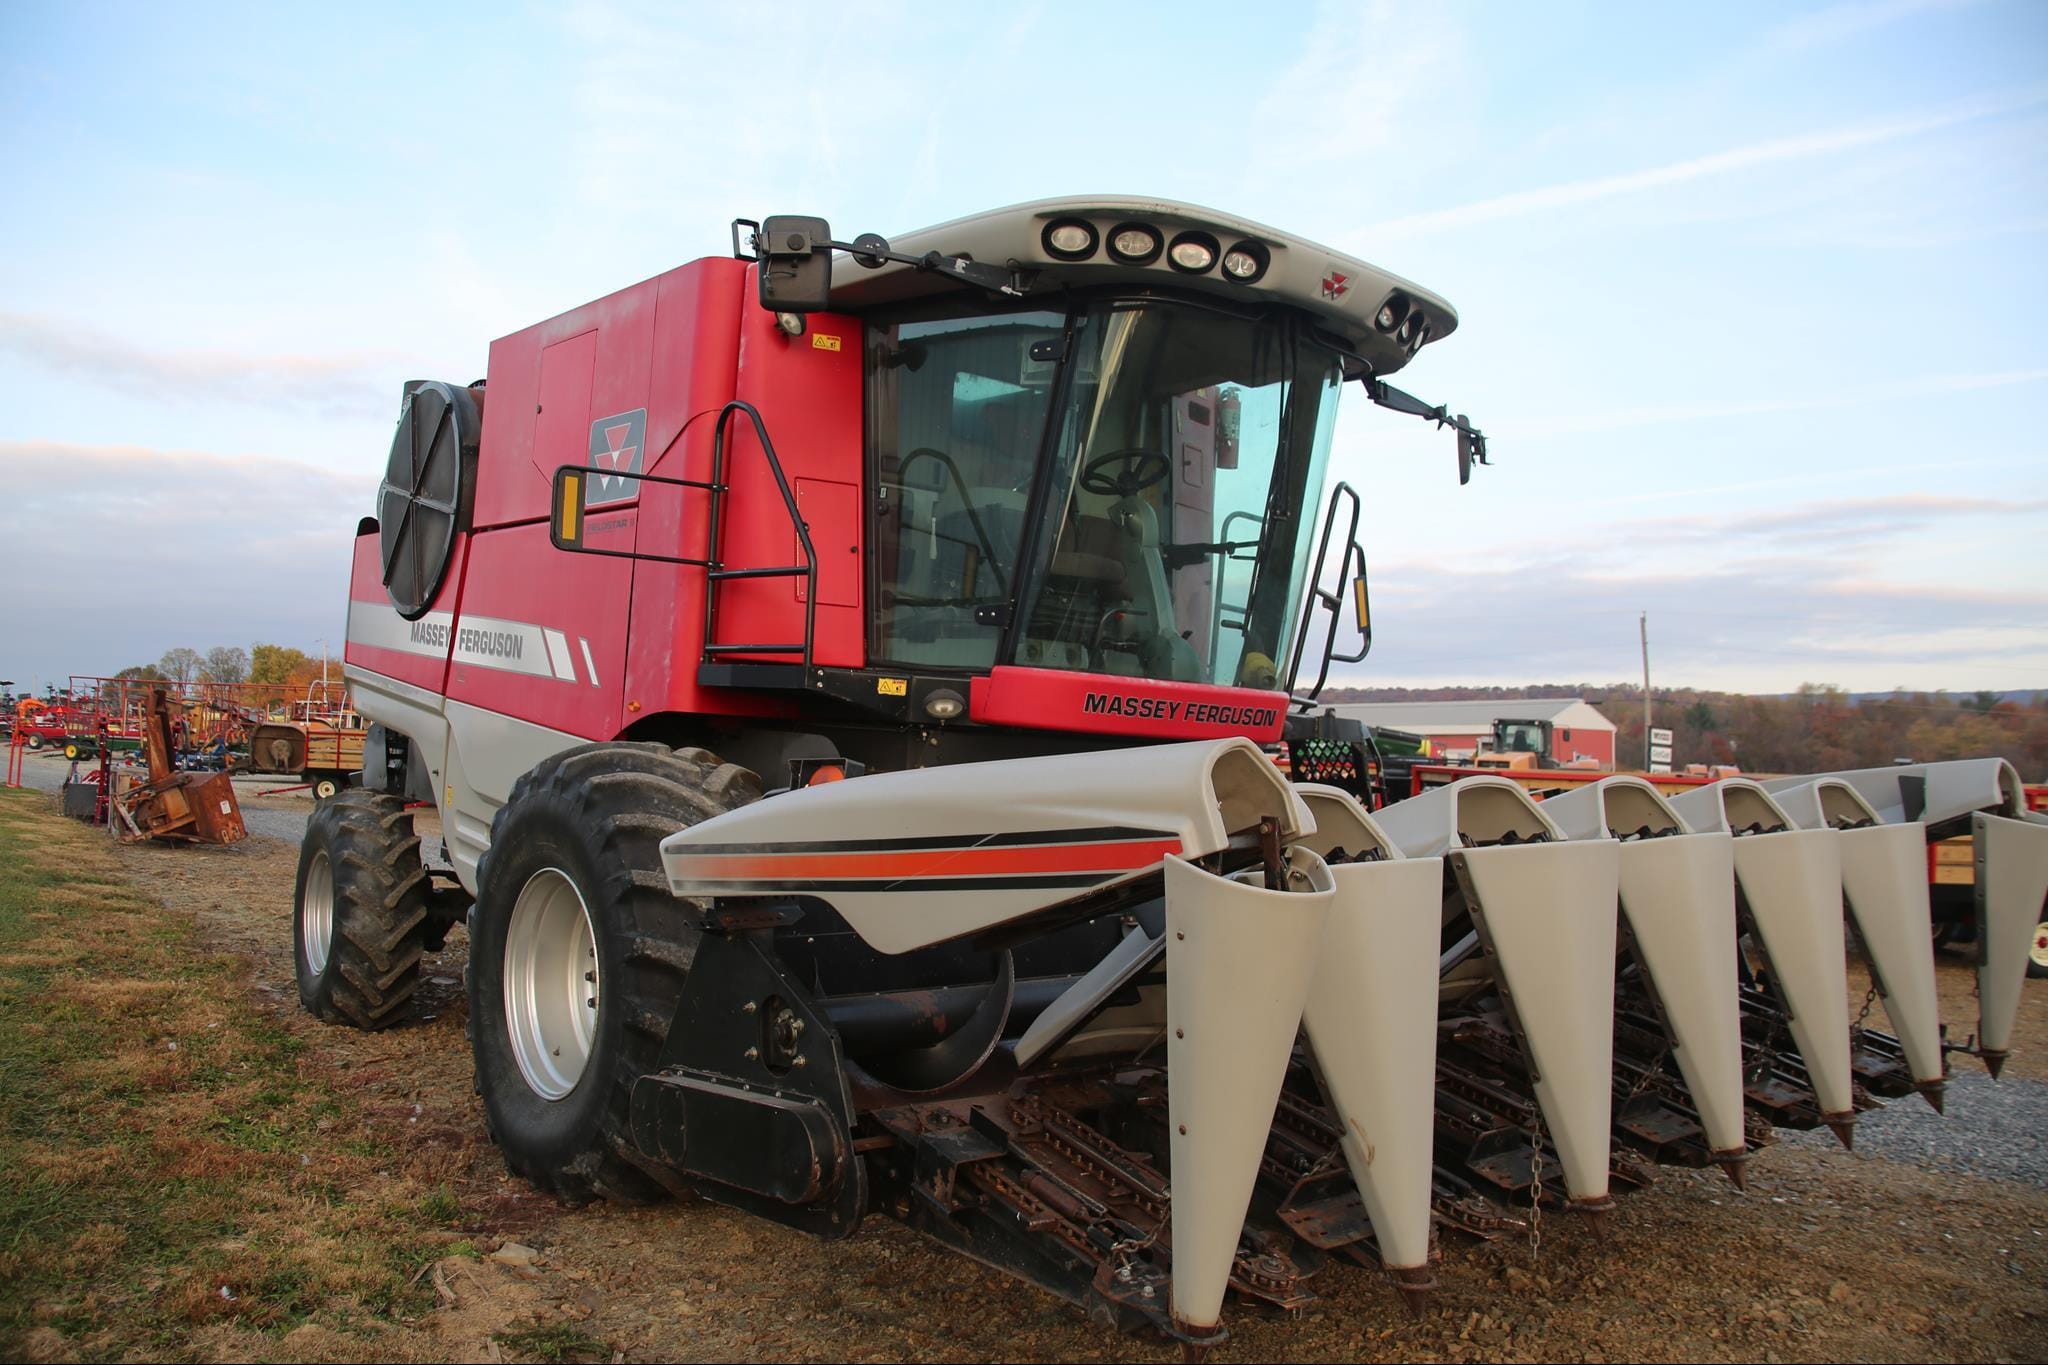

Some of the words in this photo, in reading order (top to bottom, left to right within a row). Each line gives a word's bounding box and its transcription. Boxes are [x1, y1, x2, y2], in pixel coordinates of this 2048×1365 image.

[411, 622, 452, 649] MASSEY
[459, 628, 523, 660] FERGUSON
[1084, 693, 1181, 720] MASSEY
[1184, 703, 1277, 727] FERGUSON
